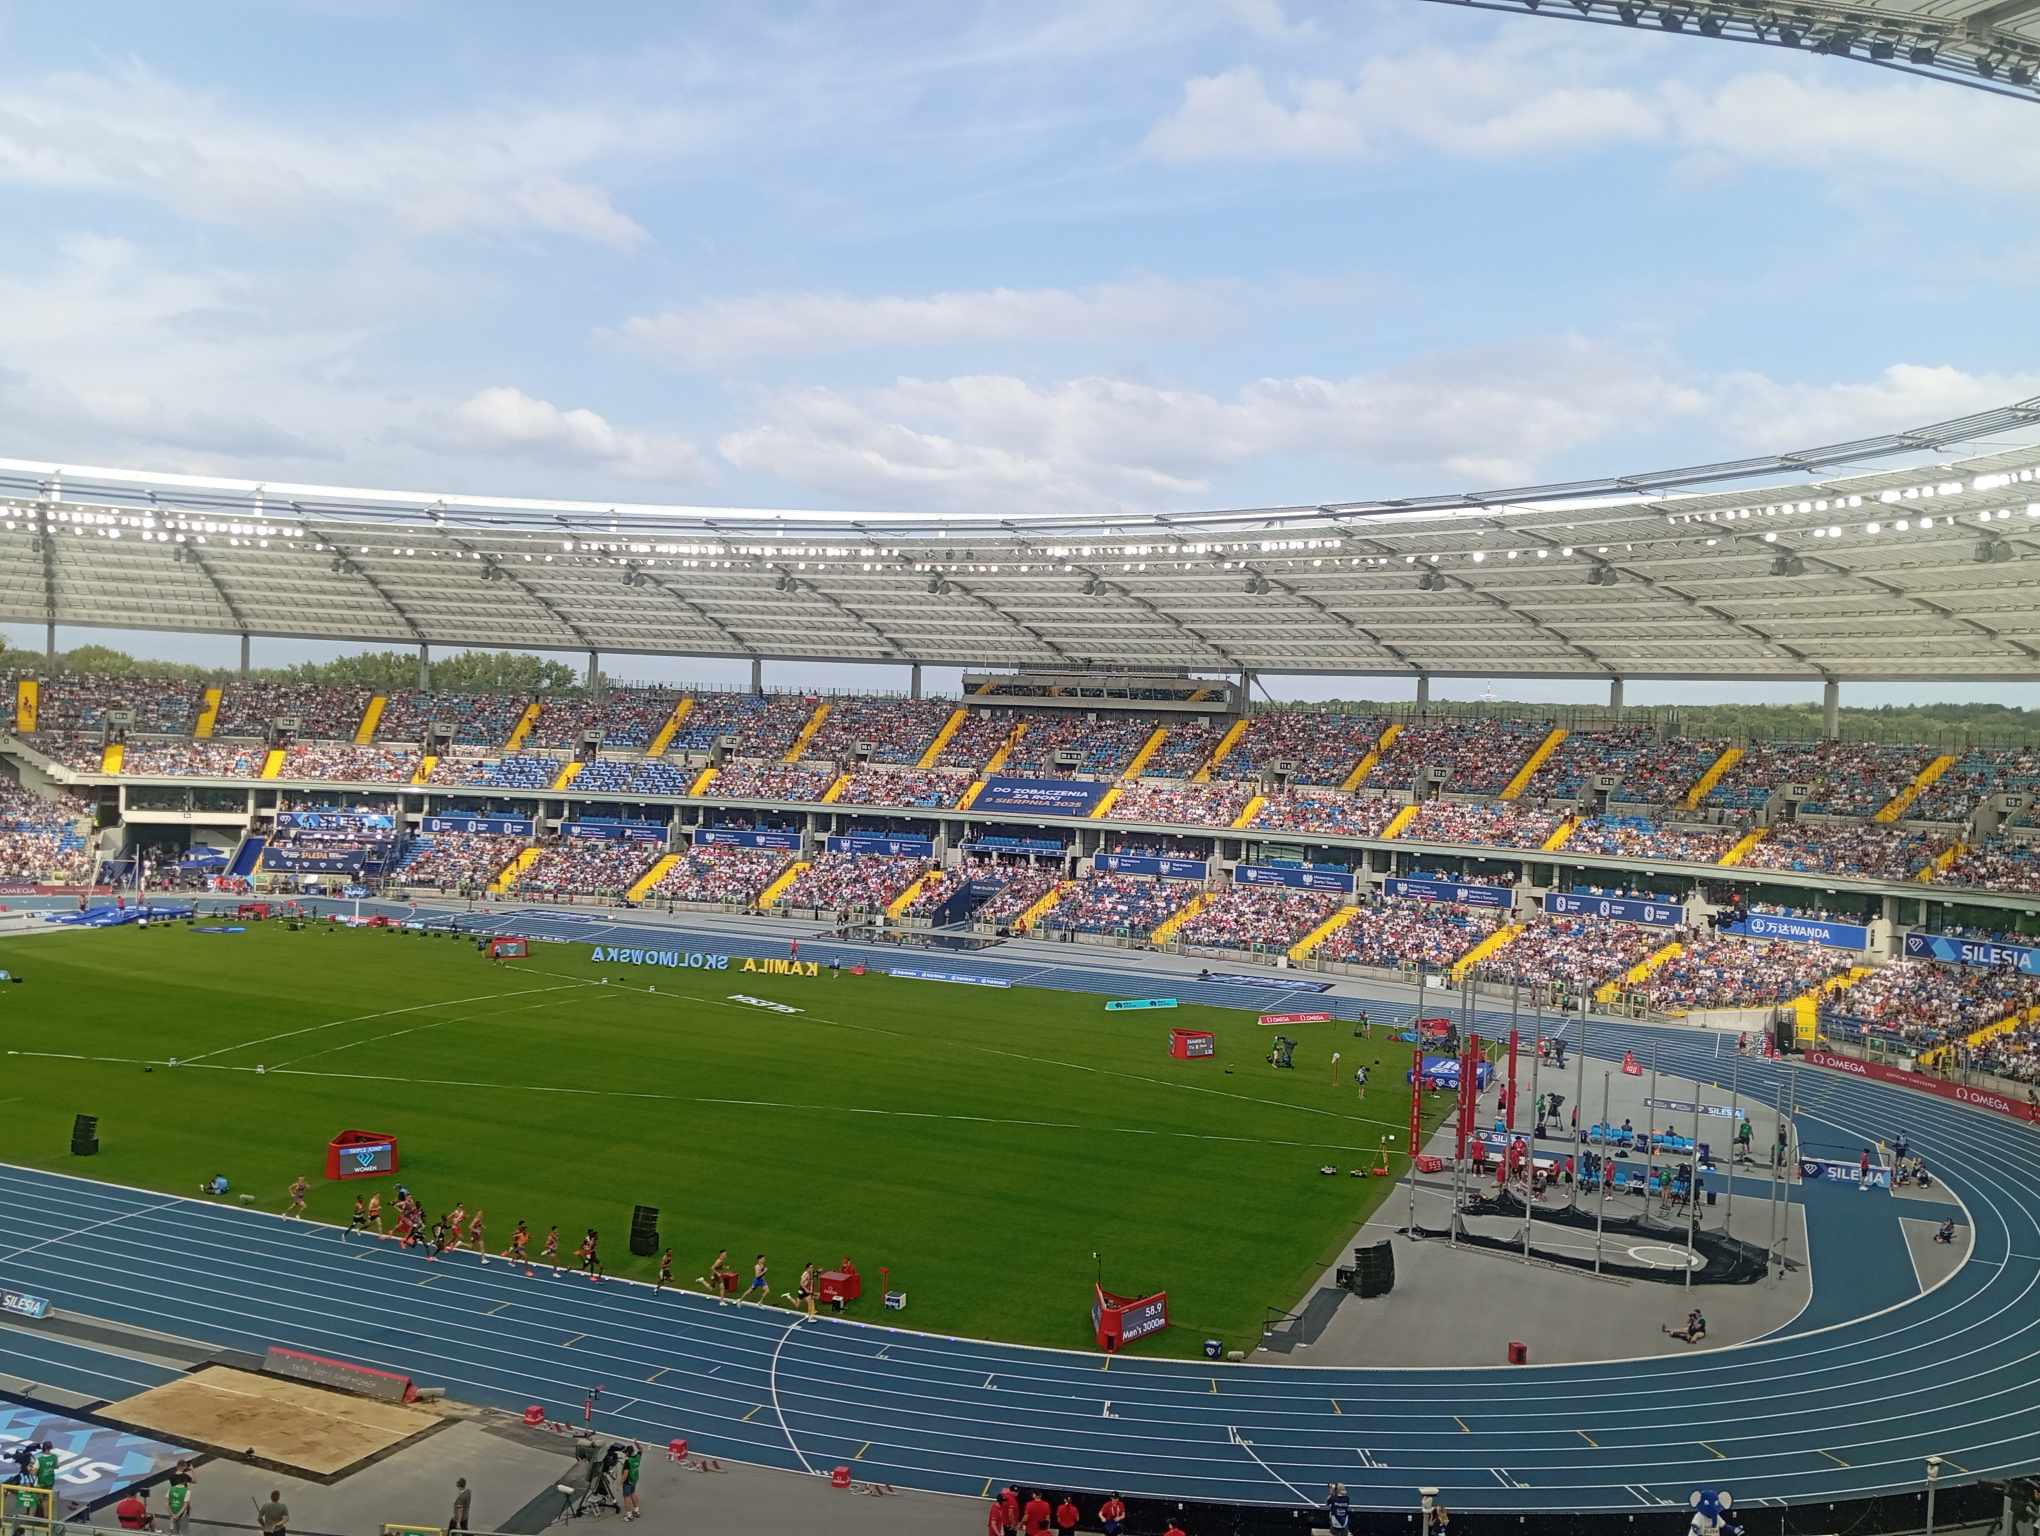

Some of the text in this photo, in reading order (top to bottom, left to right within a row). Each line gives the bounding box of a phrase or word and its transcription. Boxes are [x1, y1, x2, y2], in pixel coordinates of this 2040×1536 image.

[1012, 788, 1088, 798] ZOBACZENIA
[994, 797, 1051, 806] SIERPNIA
[0, 886, 37, 895] OMEGA
[1961, 944, 2033, 968] SILESIA
[1826, 1057, 1867, 1075] OMEGA
[1970, 1092, 2011, 1113] OMEGA
[1708, 1107, 1741, 1117] SILESA
[1827, 1168, 1885, 1186] SILEIA
[3, 1294, 41, 1313] SILESIA
[1145, 1302, 1162, 1317] 58.9
[1122, 1318, 1166, 1341] Men's 3000m
